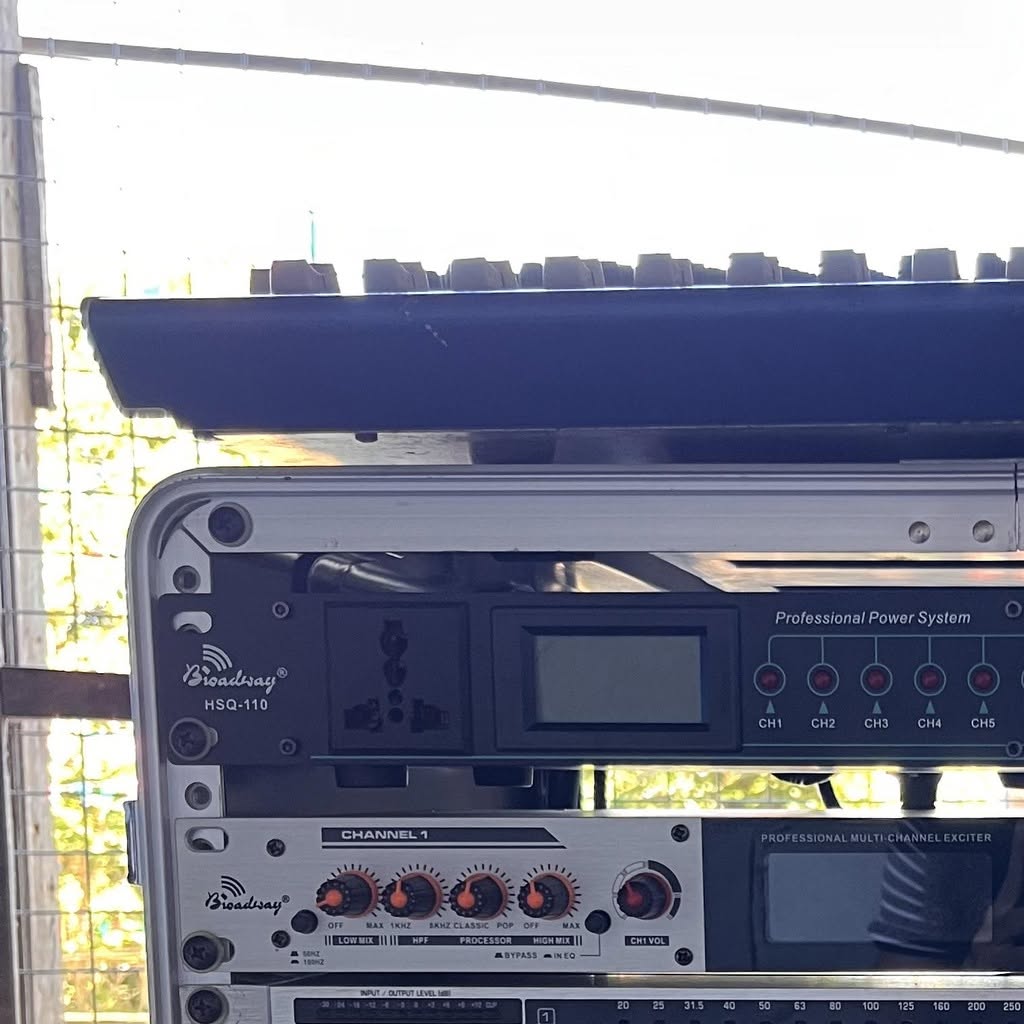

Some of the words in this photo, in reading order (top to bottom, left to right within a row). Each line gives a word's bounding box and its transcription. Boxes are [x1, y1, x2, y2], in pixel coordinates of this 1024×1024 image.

[775, 611, 866, 625] Professional
[868, 611, 914, 625] Power
[916, 611, 972, 627] System
[204, 698, 268, 711] HSQ-110
[758, 717, 783, 730] CH1
[810, 717, 836, 730] CH2
[863, 717, 889, 730] CH3
[917, 717, 942, 730] CH4
[970, 717, 996, 730] CH5
[341, 830, 418, 840] CHANNEL
[760, 833, 848, 844] PROFESSIONAL
[850, 833, 942, 843] MULTI-CHANNEL
[943, 832, 992, 843] EXCITER
[327, 922, 344, 930] OFF
[365, 922, 384, 930] MAX
[453, 921, 490, 930] CLASSIC
[496, 921, 514, 930] POP
[523, 921, 540, 930] OFF
[562, 921, 581, 930] MAX
[338, 936, 360, 945] LOW
[360, 936, 374, 945] MIX
[412, 936, 430, 945] HPF
[459, 936, 512, 945] PROCESSOR
[532, 936, 554, 945] HIGH
[555, 936, 571, 945] MIX
[630, 936, 648, 946] CH1
[648, 936, 666, 946] VOL
[563, 952, 576, 960] EQ
[616, 1000, 630, 1012] 20
[652, 1000, 665, 1012] 25
[683, 1000, 705, 1012] 31.5
[722, 1000, 736, 1012] 40
[758, 1000, 772, 1012] 50
[793, 1000, 807, 1012] 63
[828, 1000, 842, 1012] 80
[862, 1000, 880, 1012] 100
[897, 1000, 915, 1012] 125
[932, 1000, 950, 1012] 160
[967, 1000, 986, 1012] 200
[1002, 1001, 1021, 1013] 250
